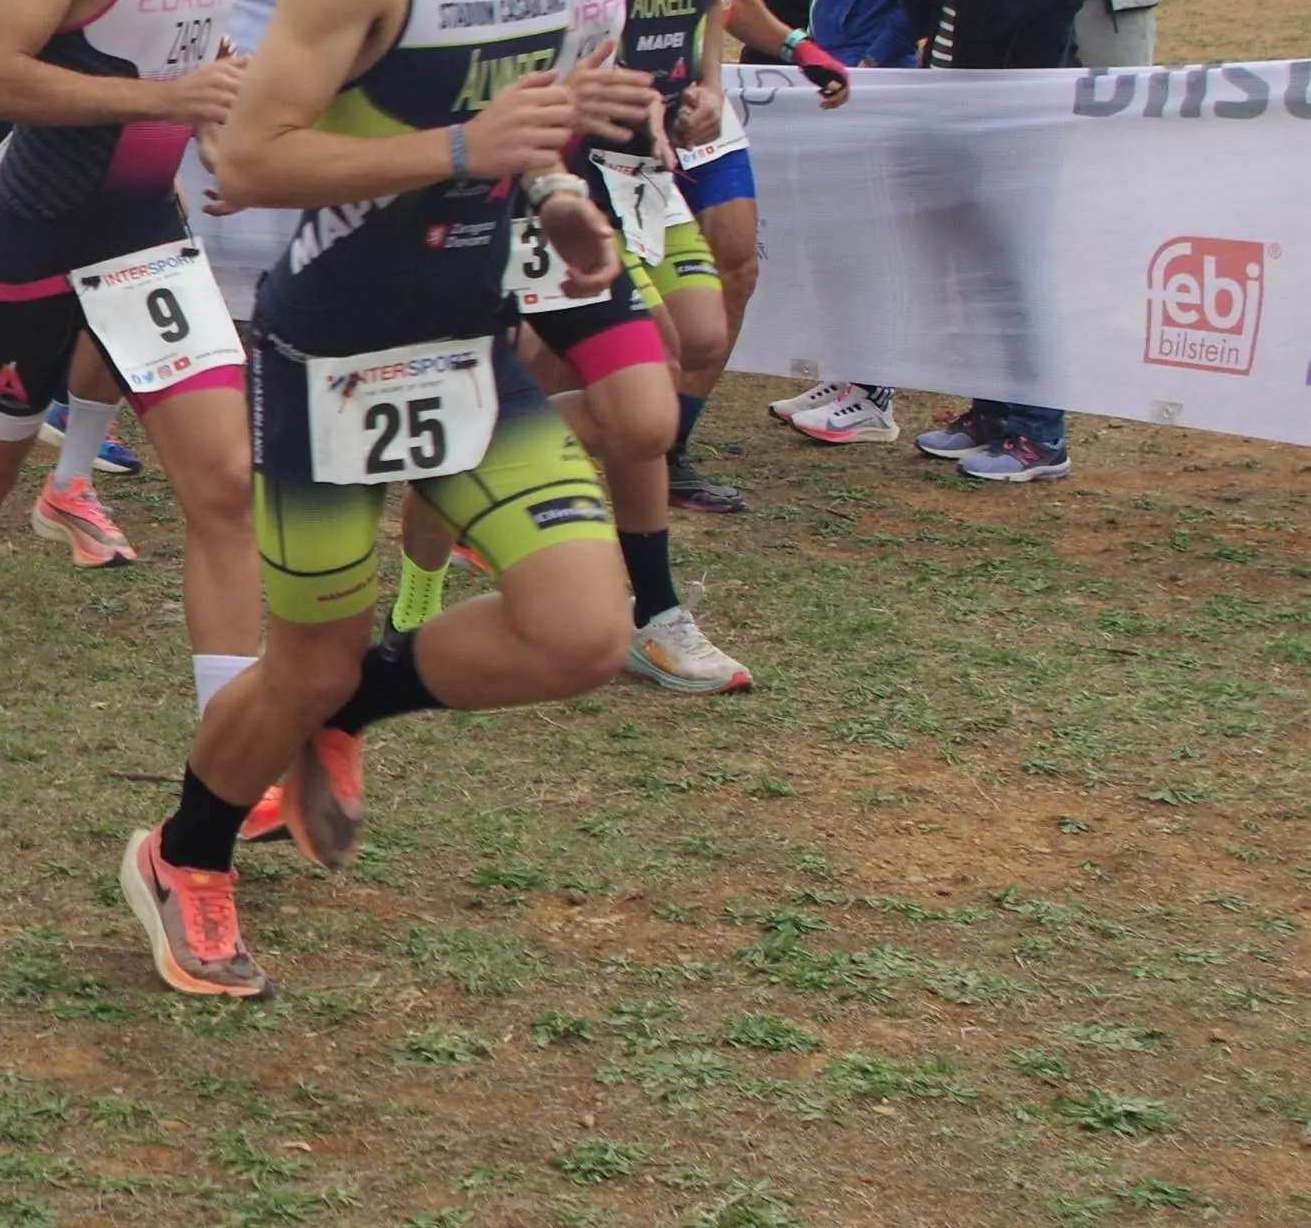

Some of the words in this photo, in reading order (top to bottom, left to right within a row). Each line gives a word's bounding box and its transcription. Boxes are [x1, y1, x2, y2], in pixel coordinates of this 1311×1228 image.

[147, 288, 190, 343] 9
[1146, 240, 1264, 332] febi
[1158, 329, 1240, 367] bilstein
[364, 396, 446, 474] 25
